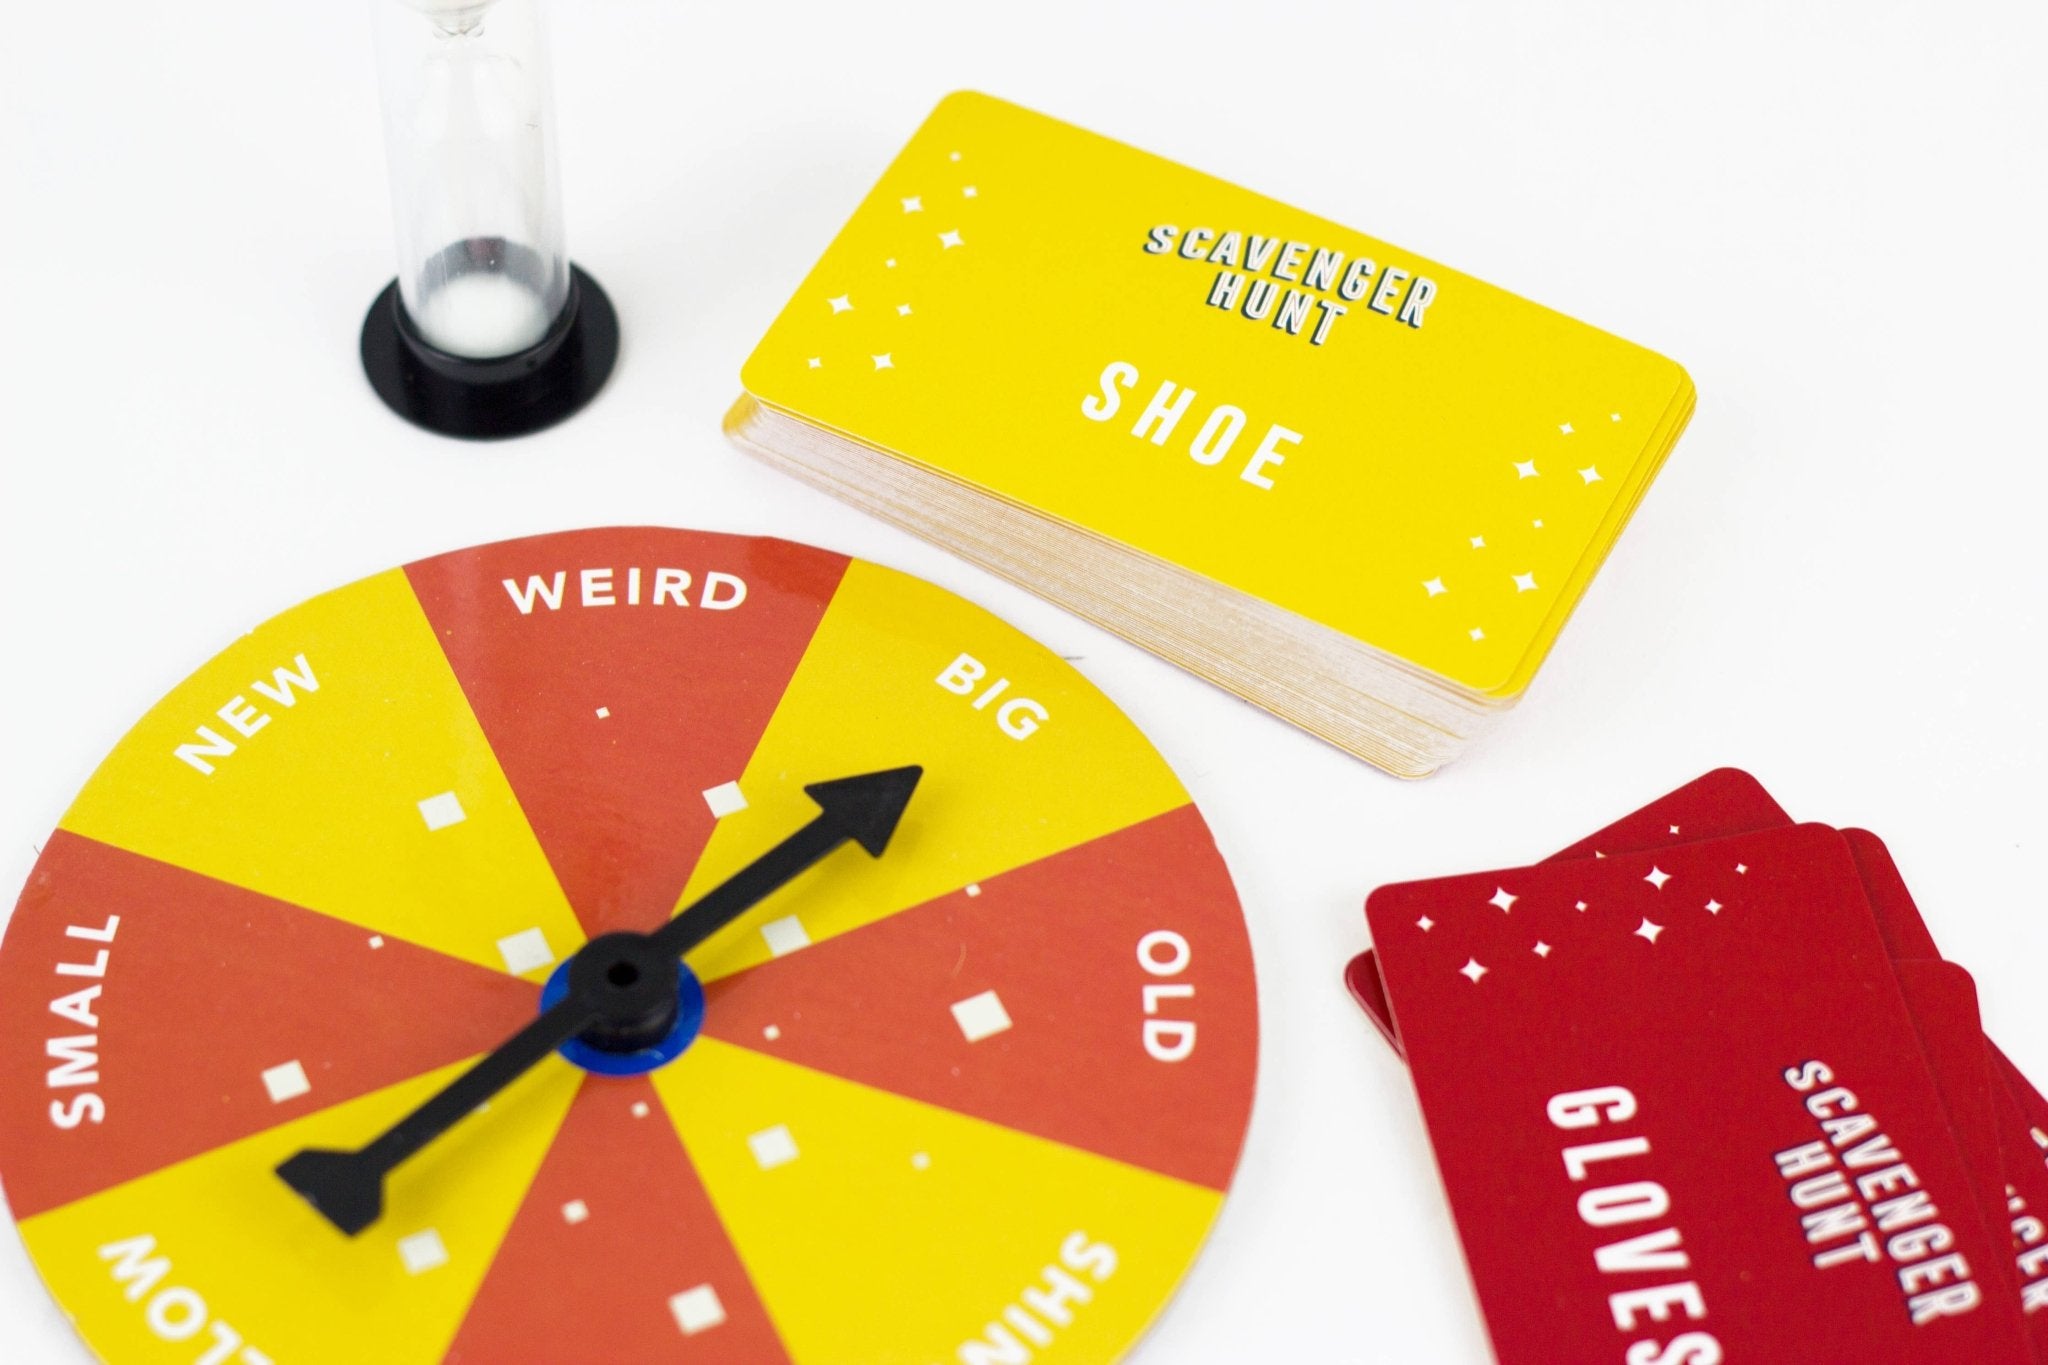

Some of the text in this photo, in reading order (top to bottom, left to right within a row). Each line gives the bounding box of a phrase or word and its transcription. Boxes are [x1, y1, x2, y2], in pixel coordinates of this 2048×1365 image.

[1143, 224, 1438, 328] SCAVENGER
[1206, 270, 1347, 345] HUNT
[1081, 361, 1303, 490] SHOE
[502, 567, 748, 615] WEIRD
[173, 653, 320, 776] NEW
[935, 652, 1050, 741] BIG
[46, 914, 121, 1130] SMALL
[1136, 929, 1197, 1063] OLD
[1546, 1085, 1722, 1365] GLOVES
[1773, 1140, 1881, 1269] HUNT
[1782, 1059, 1981, 1326] SCAVENGER
[932, 1230, 1118, 1365] SHIN
